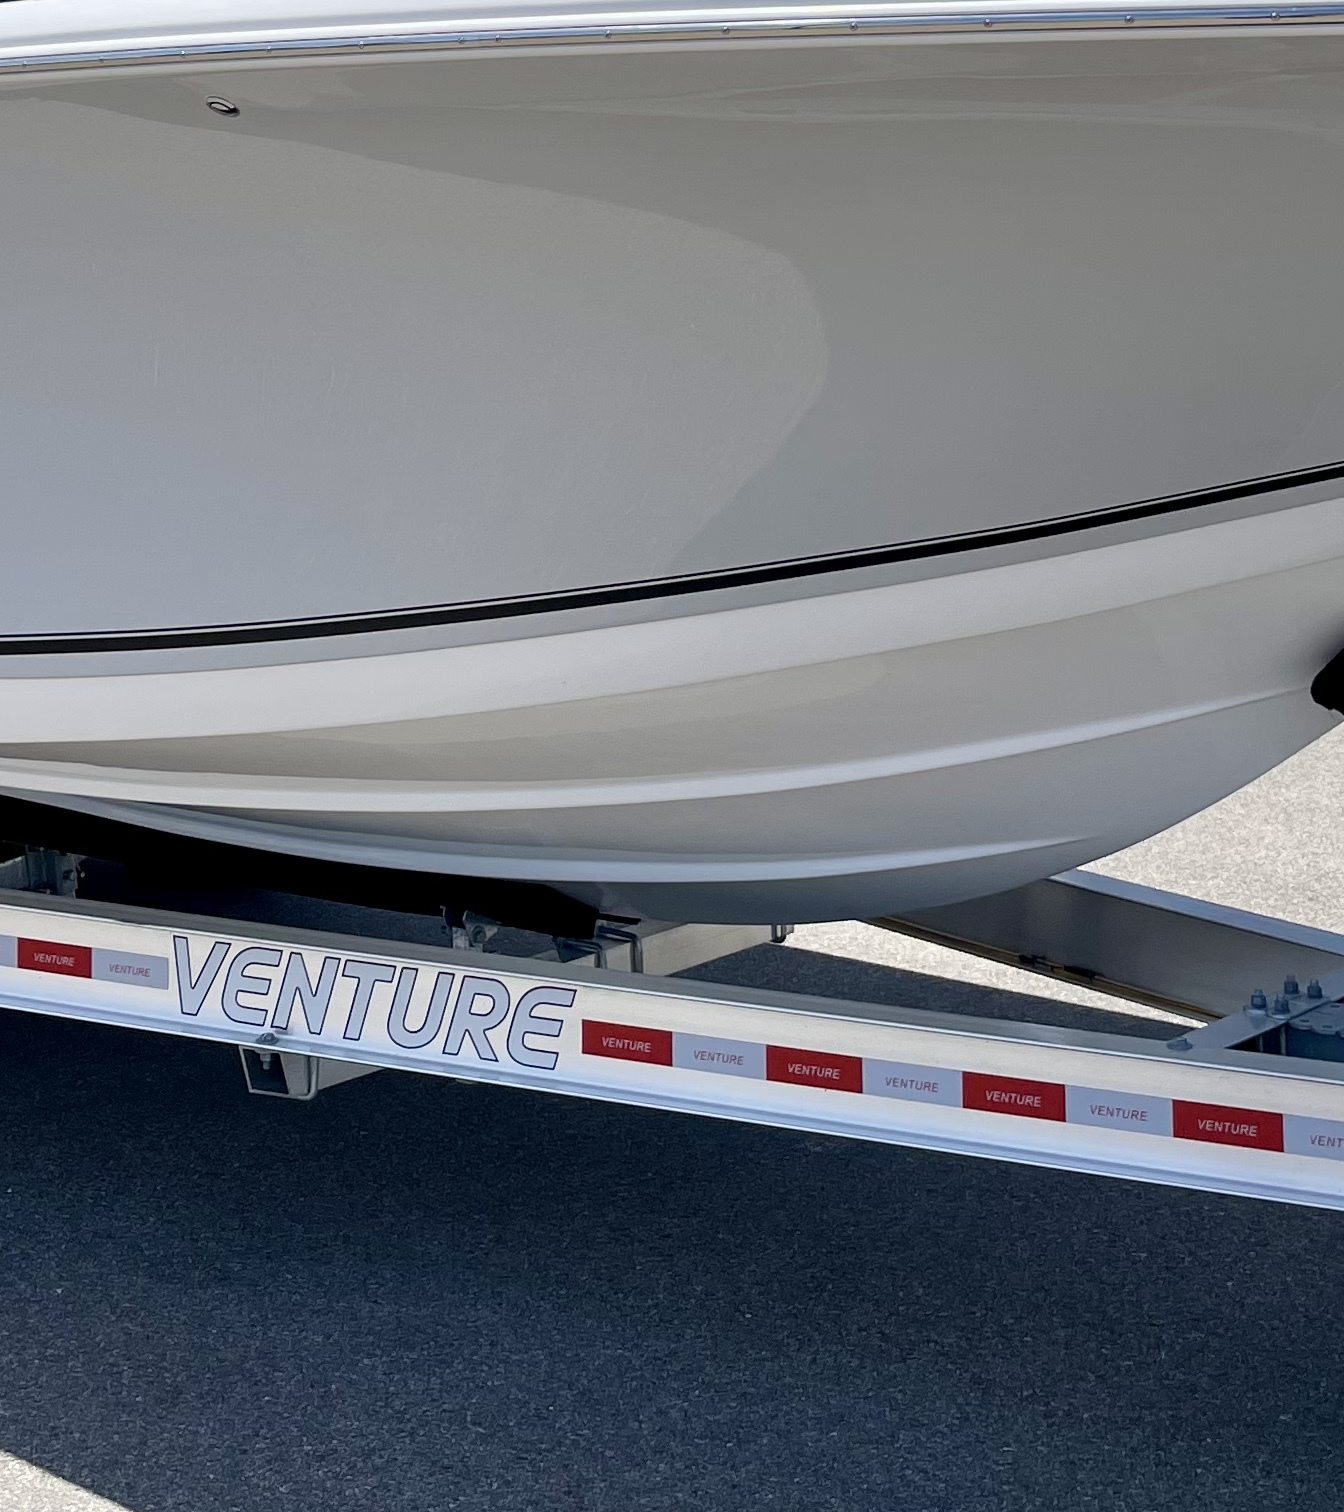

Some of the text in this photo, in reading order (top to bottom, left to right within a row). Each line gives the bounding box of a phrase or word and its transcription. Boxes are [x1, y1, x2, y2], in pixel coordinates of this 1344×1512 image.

[33, 953, 74, 967] VENTURE
[109, 963, 151, 978] VENTURE
[172, 935, 577, 1070] VENTURE
[601, 1036, 651, 1053] VENTURE
[693, 1049, 744, 1066] VENTURE
[787, 1062, 840, 1079] VENTURE
[884, 1076, 939, 1092] VENTURE
[985, 1090, 1041, 1107] VENTURE
[1089, 1104, 1148, 1122] VENTURE
[1197, 1119, 1258, 1137] VENTURE
